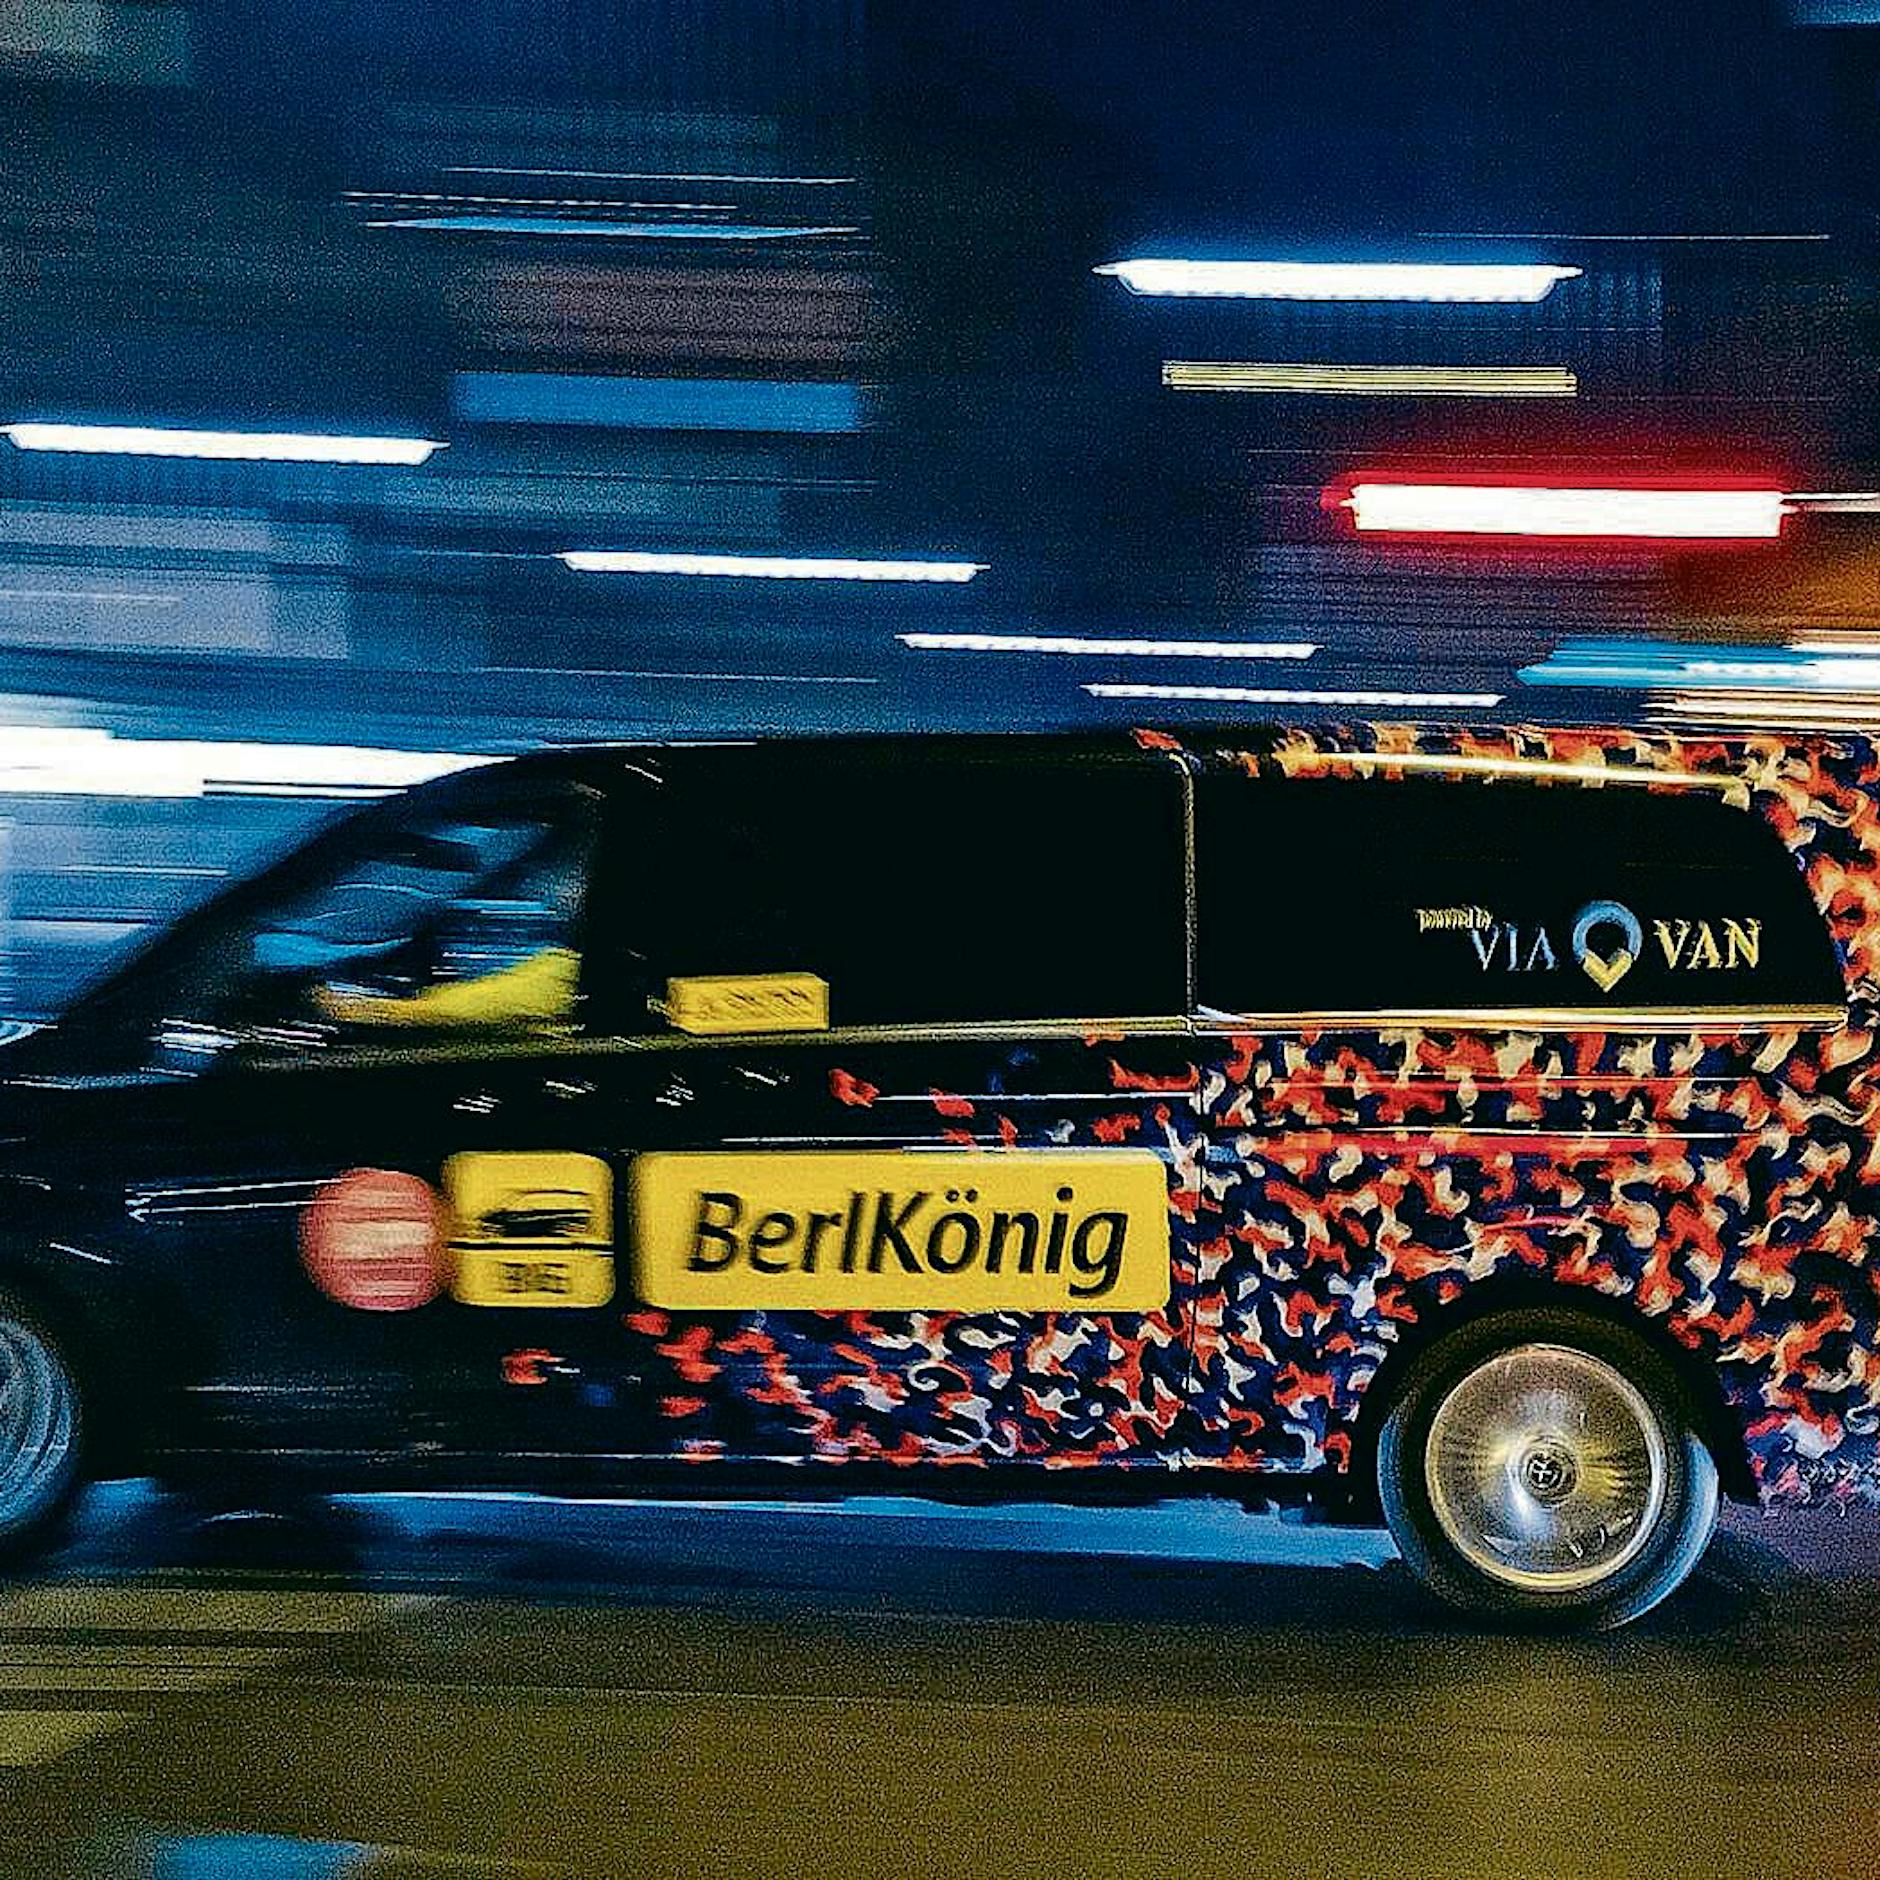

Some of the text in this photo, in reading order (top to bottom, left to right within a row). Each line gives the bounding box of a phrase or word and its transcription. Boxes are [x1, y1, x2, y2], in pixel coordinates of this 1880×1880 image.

[1471, 917, 1763, 972] VIA VAN
[687, 1186, 1129, 1299] BerlKönig
